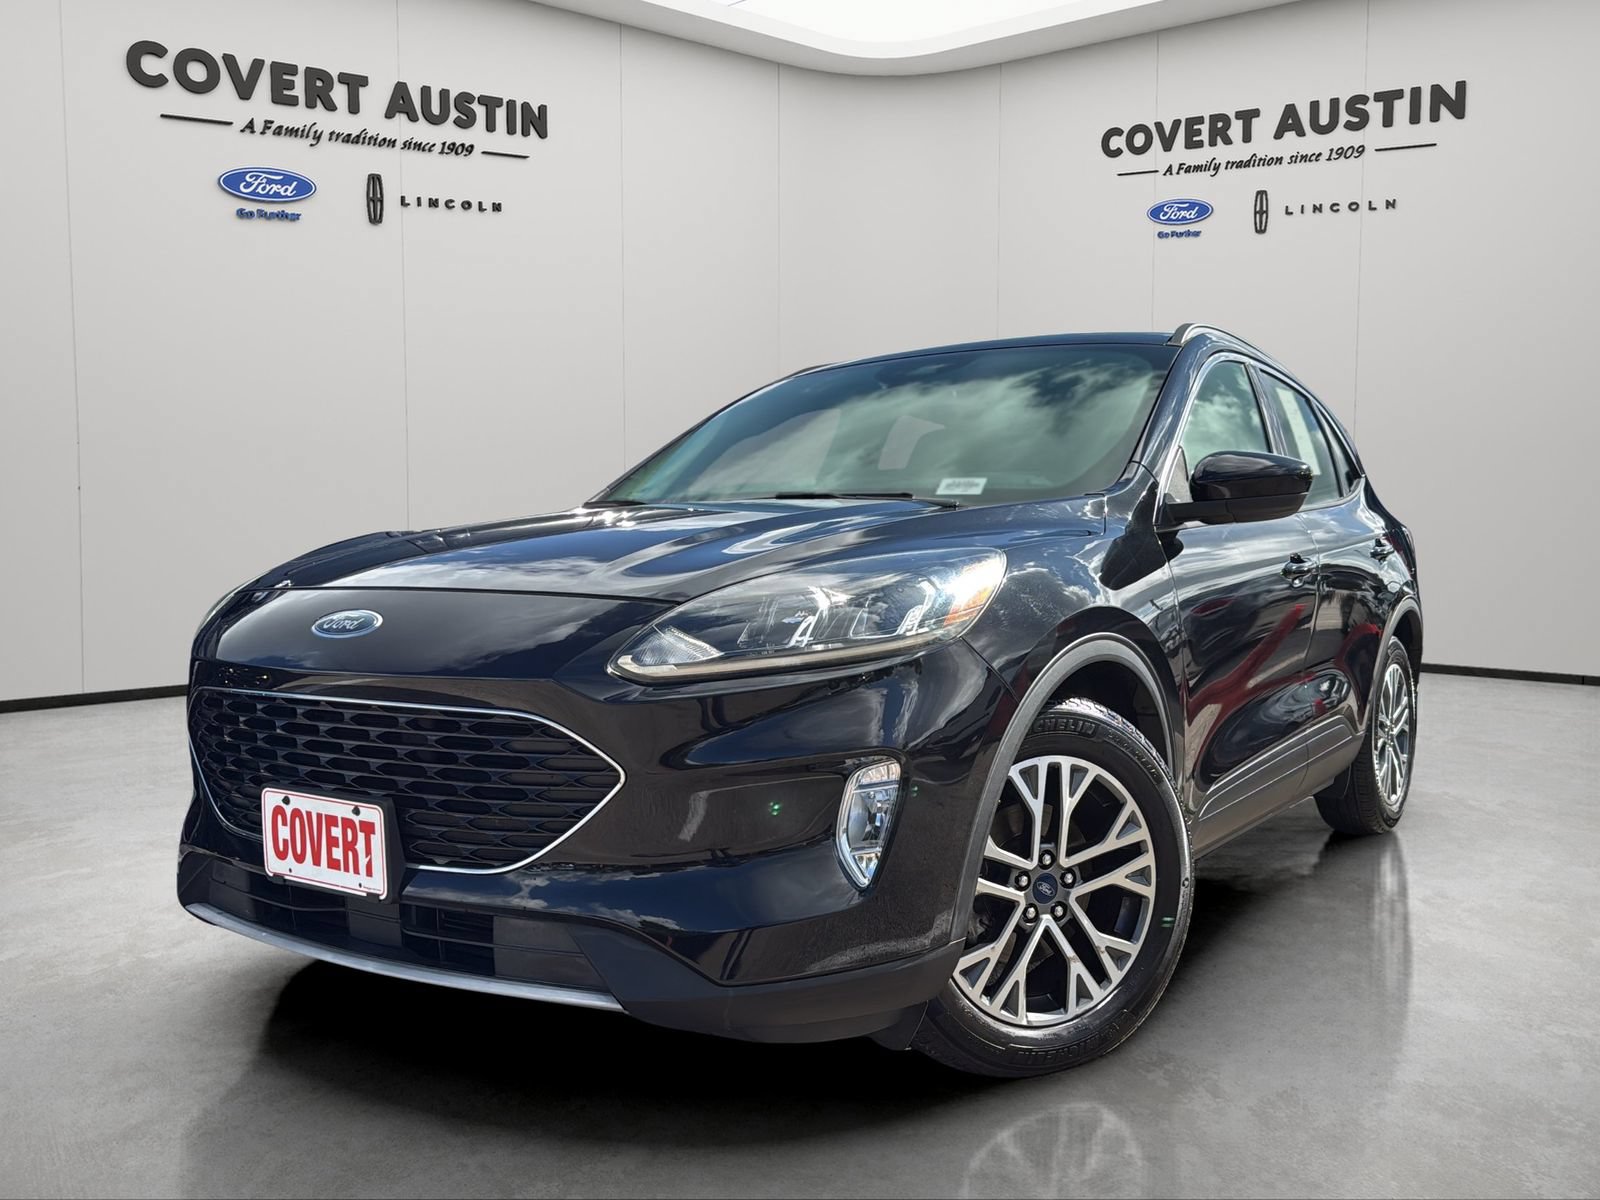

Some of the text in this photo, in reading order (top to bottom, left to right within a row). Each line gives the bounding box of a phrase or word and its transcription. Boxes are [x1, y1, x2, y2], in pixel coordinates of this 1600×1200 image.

[126, 40, 548, 139] COVERT AUSTIN
[1101, 80, 1467, 158] COVERT AUSTIN
[240, 117, 475, 157] A Family tradition since 1909
[1163, 144, 1366, 177] A Family tradition since 1909
[240, 172, 298, 196] Ford
[400, 195, 503, 213] LINCOLN
[1160, 203, 1199, 220] Ford
[1285, 198, 1397, 216] LINCOLN
[323, 614, 366, 630] Ford
[1033, 717, 1097, 736] CHELIN
[271, 804, 376, 877] COVERT
